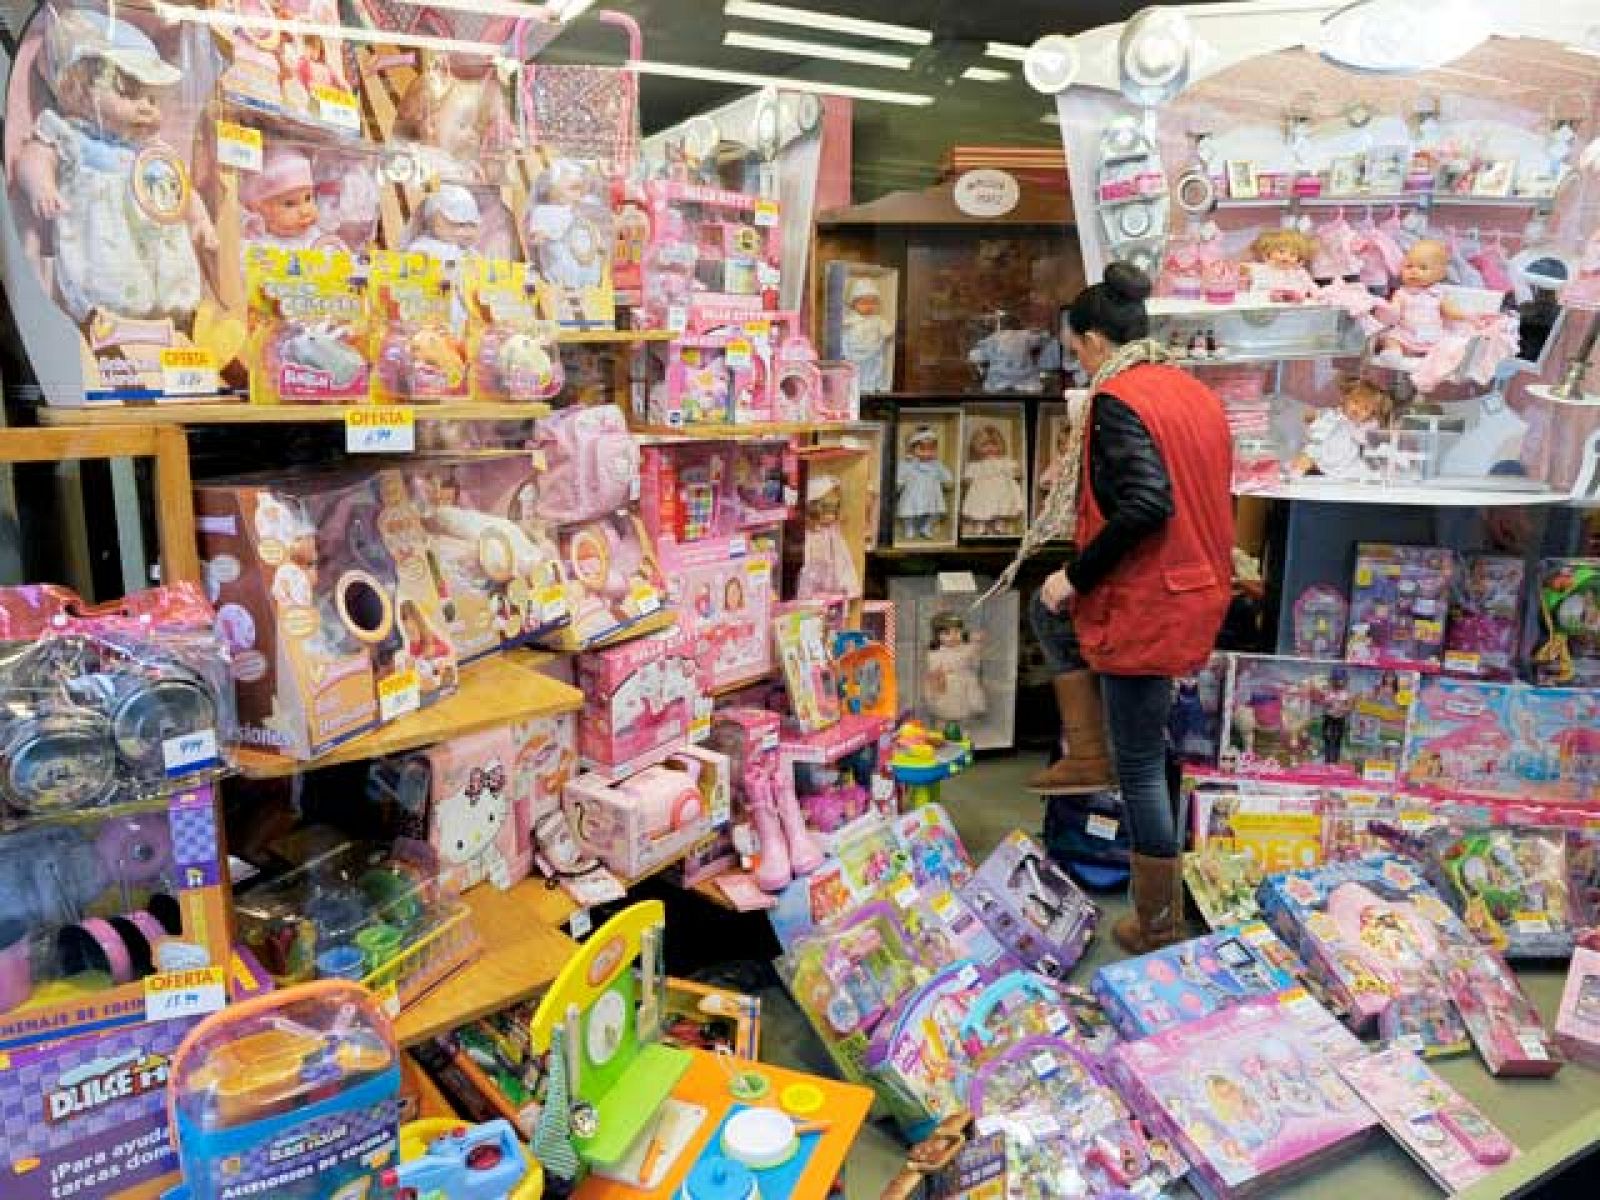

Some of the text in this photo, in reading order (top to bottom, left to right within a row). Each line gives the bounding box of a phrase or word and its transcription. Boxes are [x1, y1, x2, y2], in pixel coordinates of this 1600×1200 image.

[350, 412, 405, 425] OFERTA
[152, 969, 213, 991] OFERTA
[49, 1068, 133, 1120] DULCE
